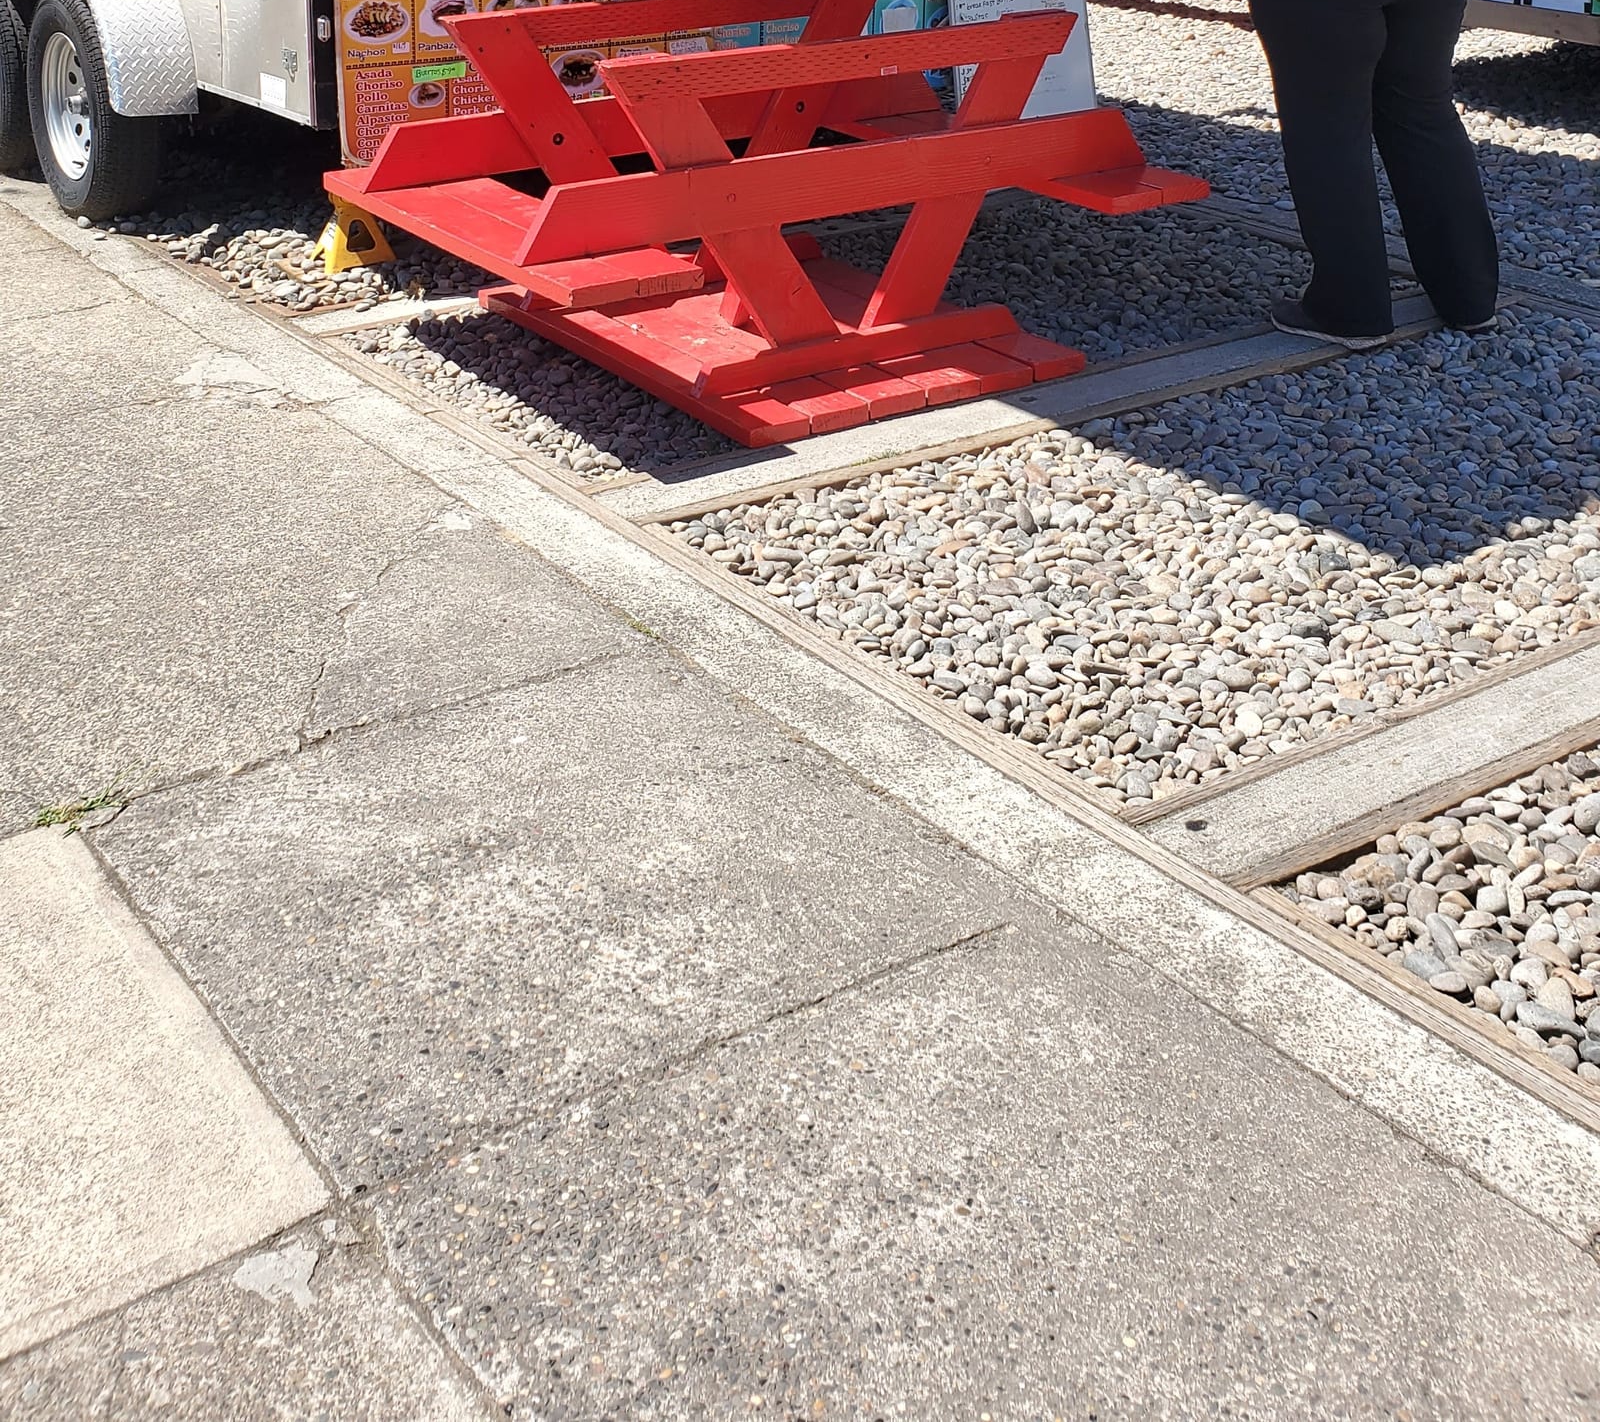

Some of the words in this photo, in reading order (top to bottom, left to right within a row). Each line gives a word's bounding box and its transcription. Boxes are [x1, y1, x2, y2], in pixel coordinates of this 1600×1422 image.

[347, 48, 386, 58] Nachos
[356, 69, 392, 79] Asada
[356, 80, 403, 92] Choriso
[356, 92, 388, 103] Pollo
[356, 103, 408, 114] Carnitas
[357, 113, 409, 126] Alpastor
[358, 125, 390, 137] Chori
